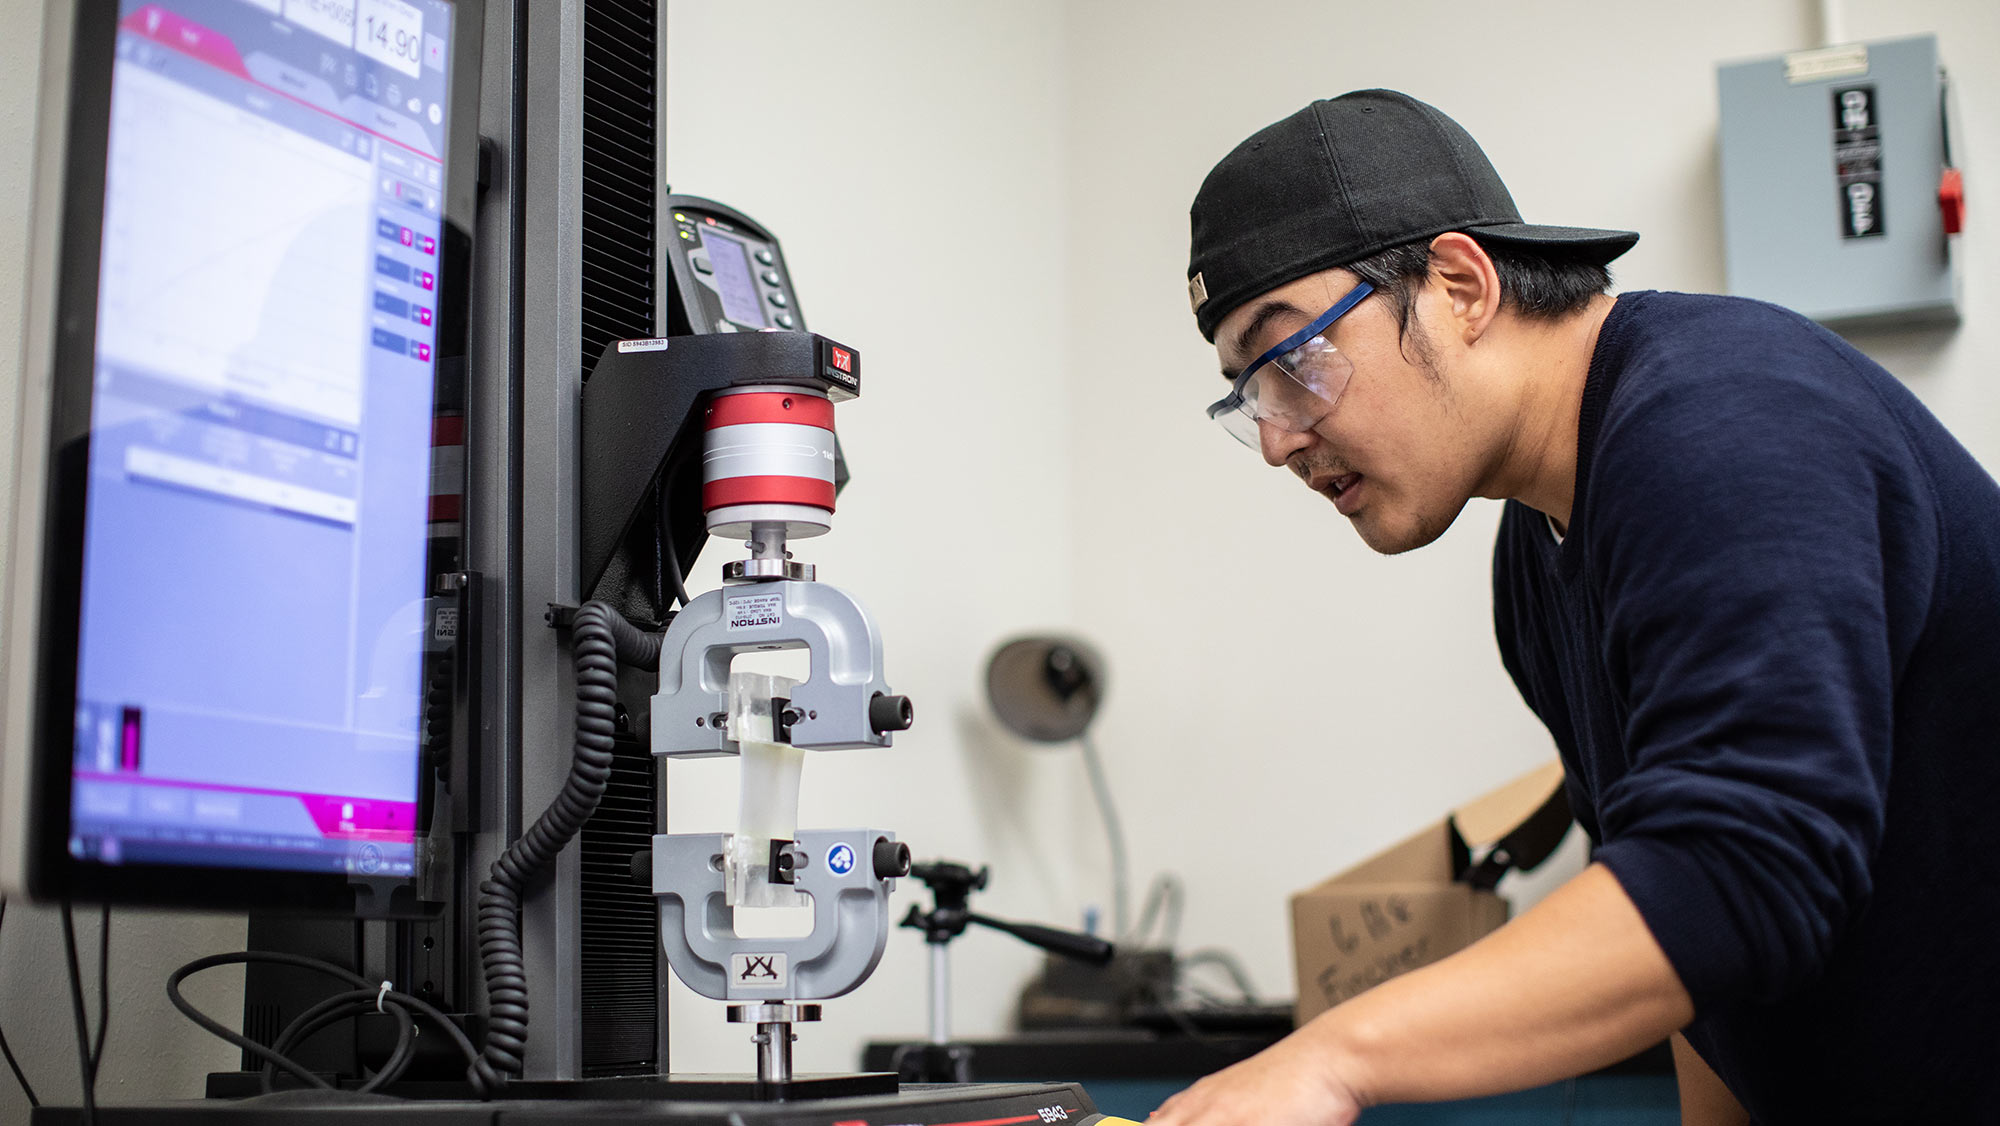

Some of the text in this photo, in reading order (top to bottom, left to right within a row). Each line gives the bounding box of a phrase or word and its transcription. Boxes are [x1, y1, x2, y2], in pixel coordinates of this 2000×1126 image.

[366, 15, 420, 63] 14.90
[826, 365, 858, 386] INSTRON
[731, 616, 780, 627] INSTRON
[1037, 1104, 1069, 1123] 5943
